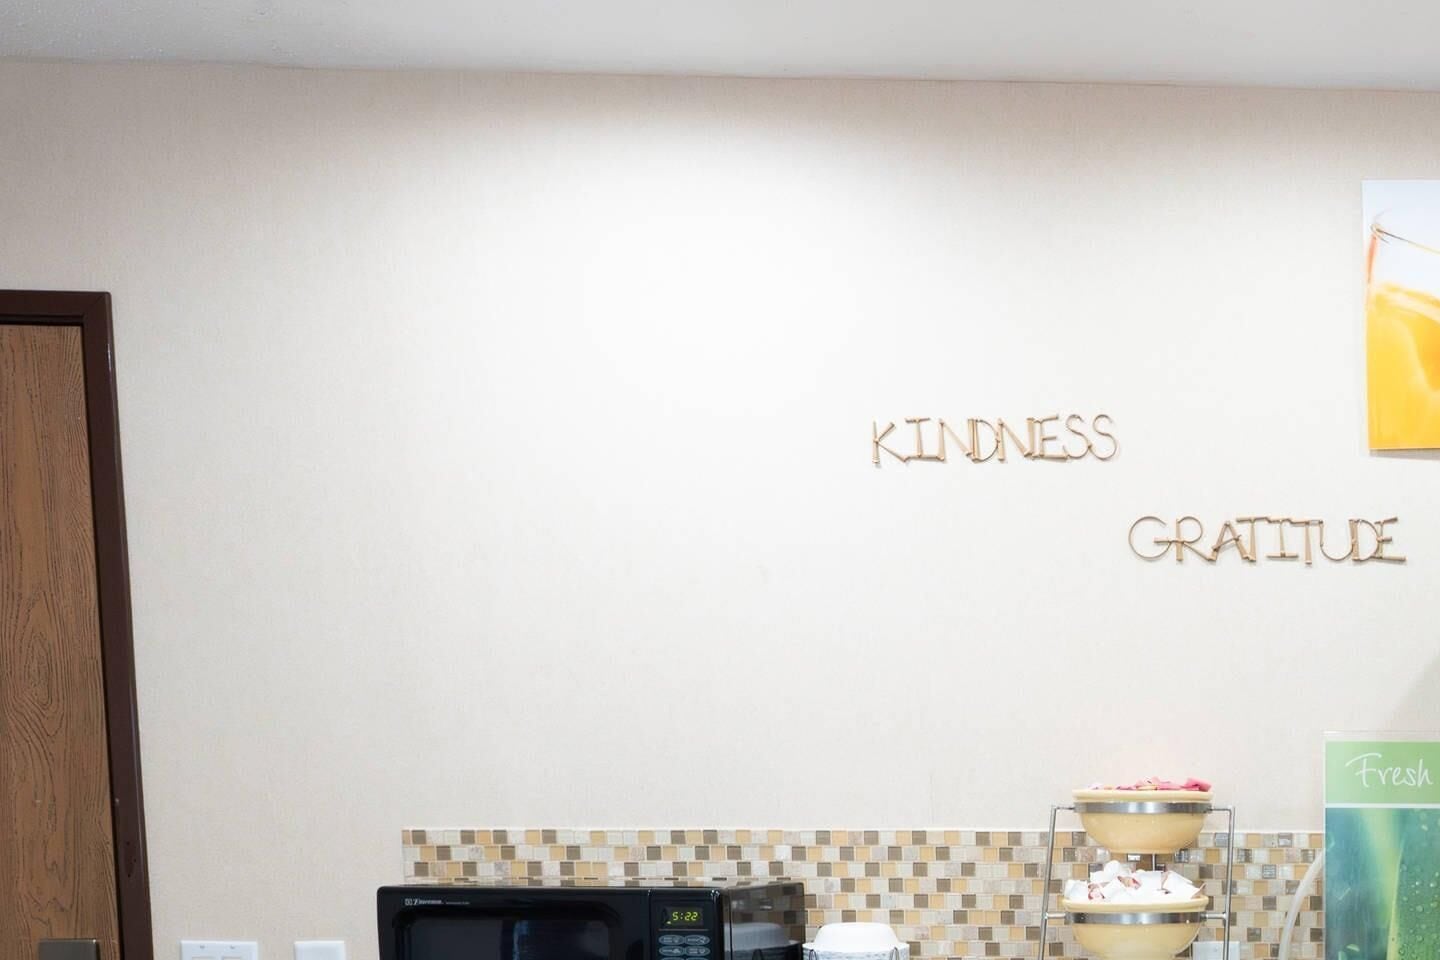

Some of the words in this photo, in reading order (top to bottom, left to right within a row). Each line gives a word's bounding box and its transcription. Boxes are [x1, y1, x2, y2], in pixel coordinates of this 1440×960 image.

[872, 414, 1118, 464] KINDNESS
[1129, 515, 1406, 565] GRATITUDE
[1345, 752, 1434, 787] Fresh
[672, 911, 698, 921] 5:22
